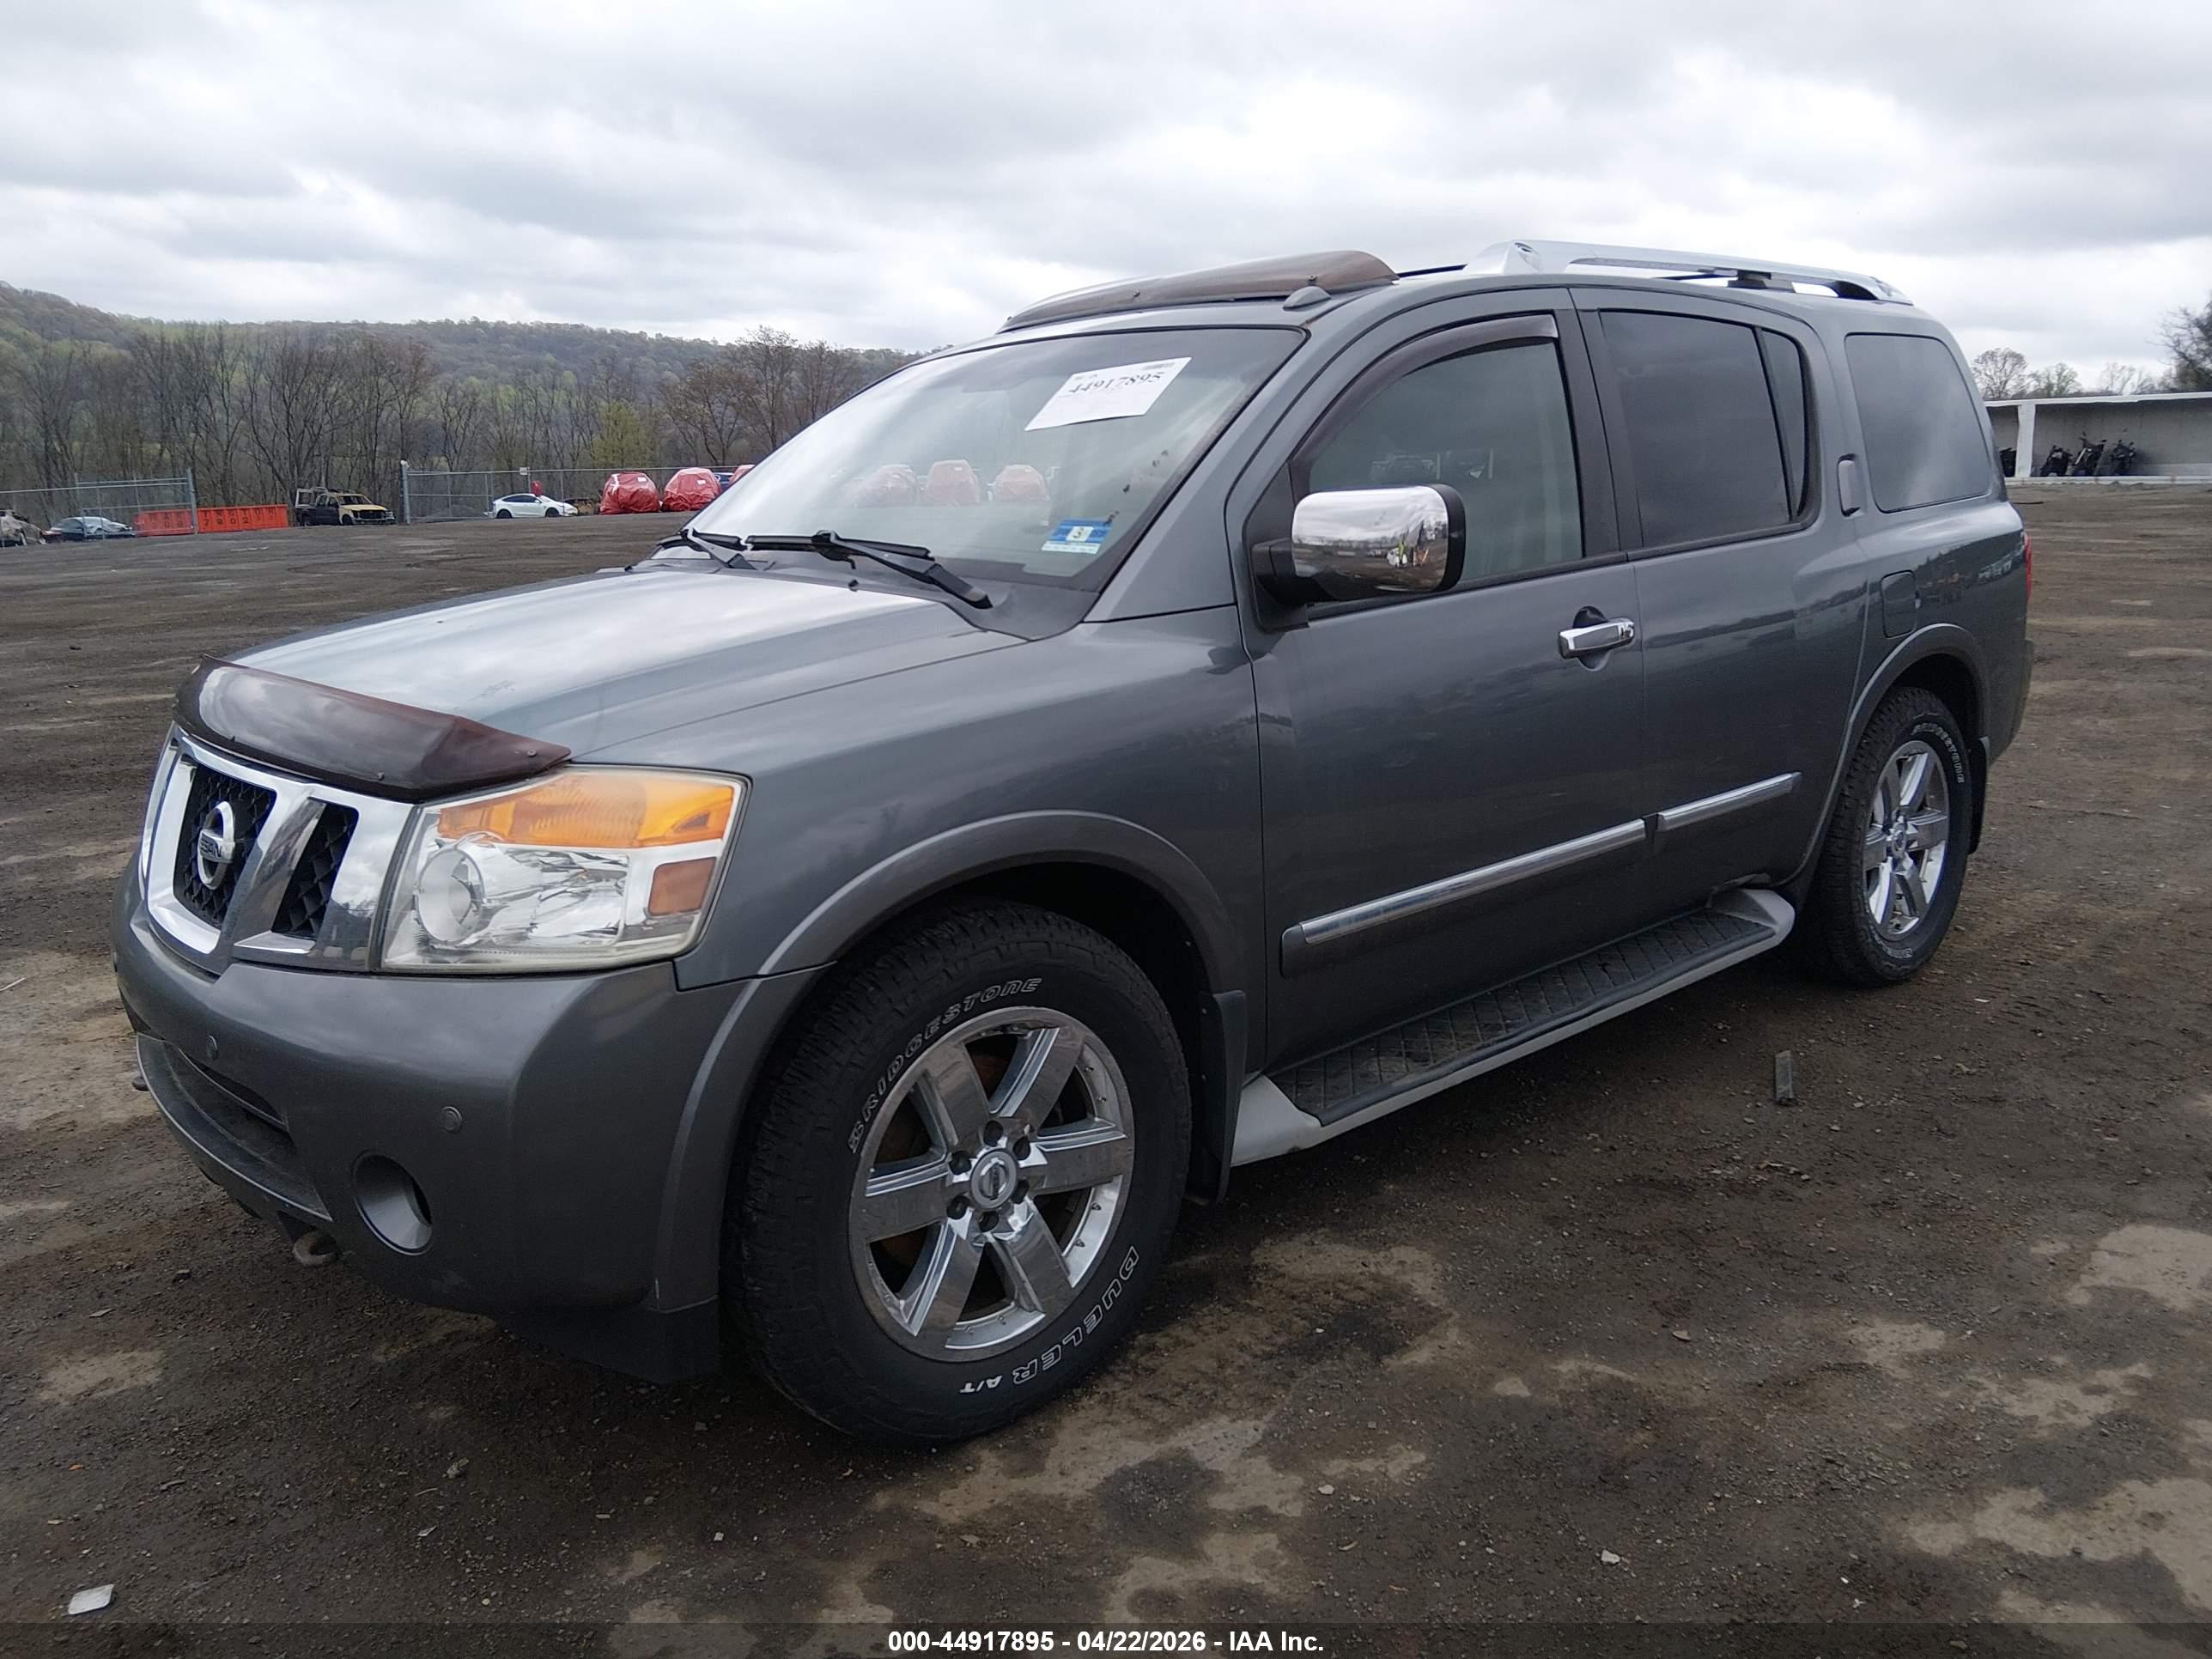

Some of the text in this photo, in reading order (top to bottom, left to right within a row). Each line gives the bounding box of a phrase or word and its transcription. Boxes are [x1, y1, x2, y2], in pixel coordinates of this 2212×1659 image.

[846, 977, 1042, 1155] BRIDGESTONE
[959, 1245, 1140, 1394] DUELER A/T
